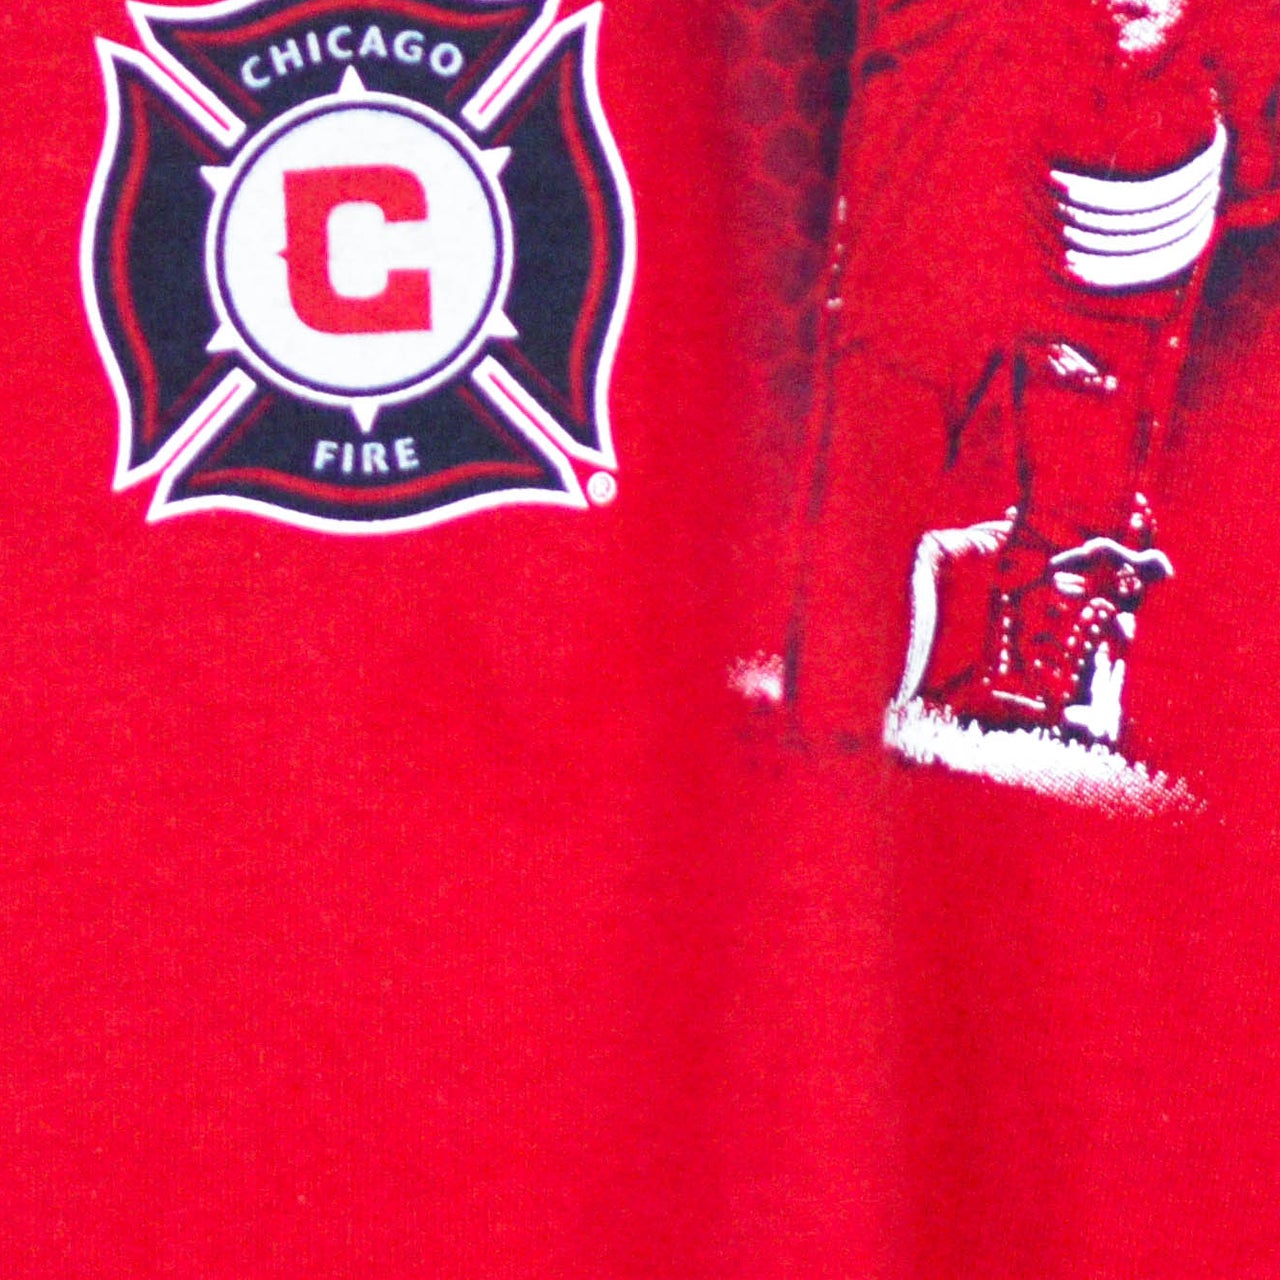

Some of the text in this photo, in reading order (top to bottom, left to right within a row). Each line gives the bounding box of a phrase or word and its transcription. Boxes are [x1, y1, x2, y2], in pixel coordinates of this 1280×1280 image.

[239, 25, 464, 90] CHICAGO
[277, 163, 432, 335] C
[312, 437, 420, 474] FIRE
